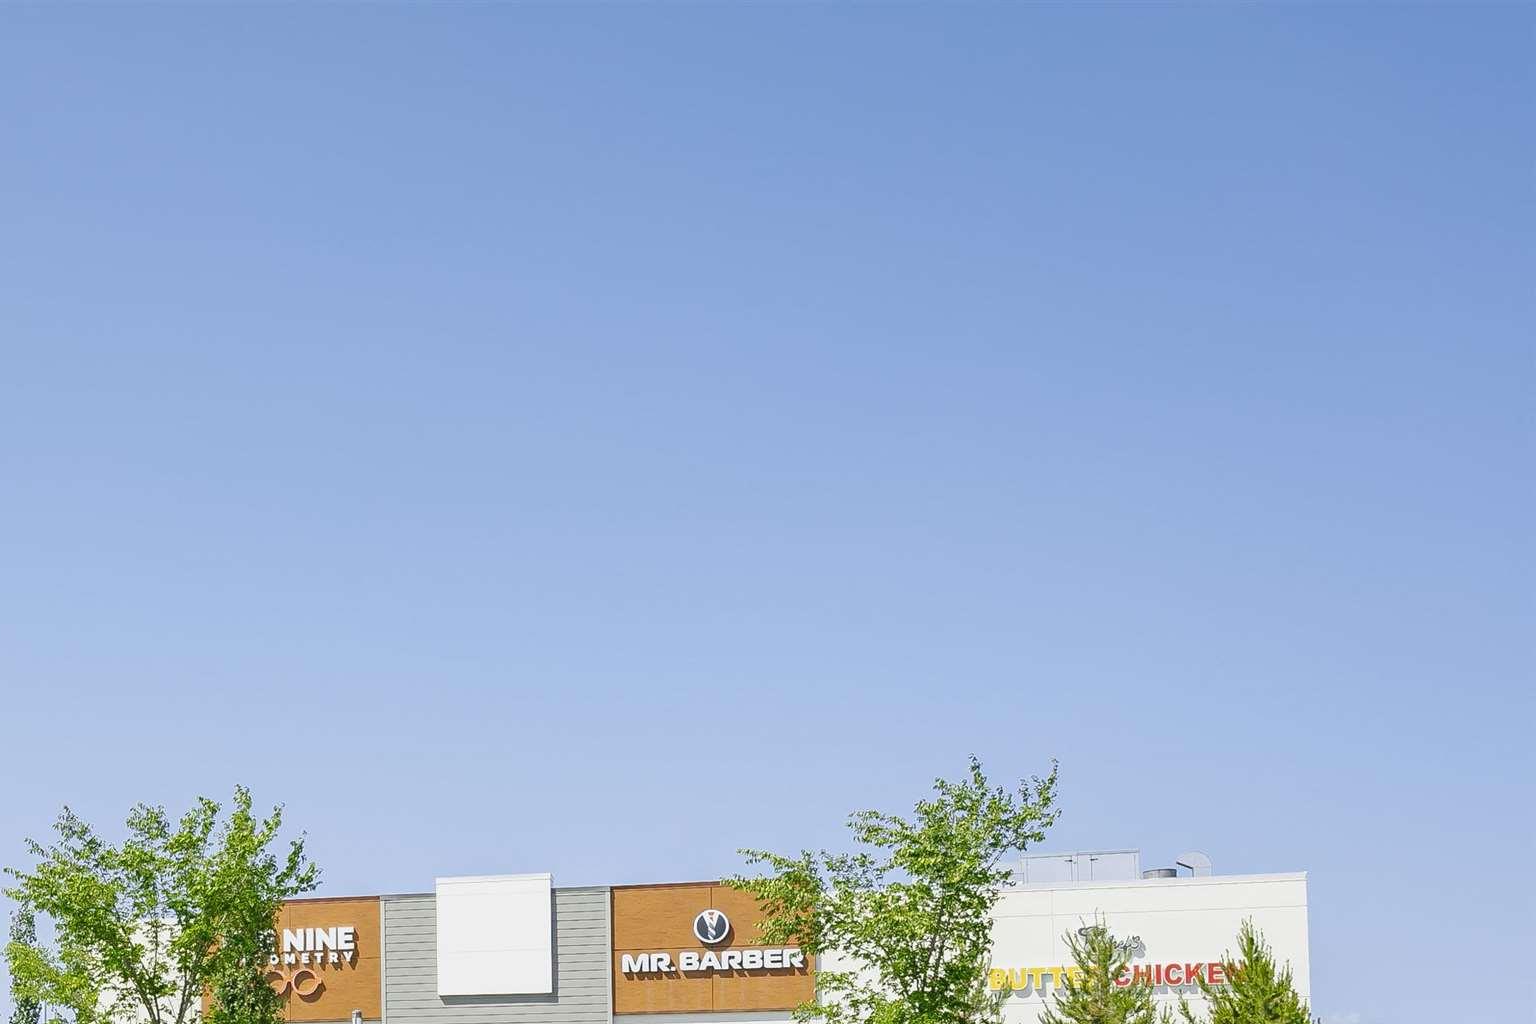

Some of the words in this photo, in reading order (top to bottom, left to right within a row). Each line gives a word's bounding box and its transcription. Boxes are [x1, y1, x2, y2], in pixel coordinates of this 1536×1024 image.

[283, 926, 355, 952] NINE
[270, 951, 354, 965] OMETRY
[621, 953, 675, 973] MR.
[679, 948, 804, 971] BARBER
[989, 966, 1102, 990] BUTTE
